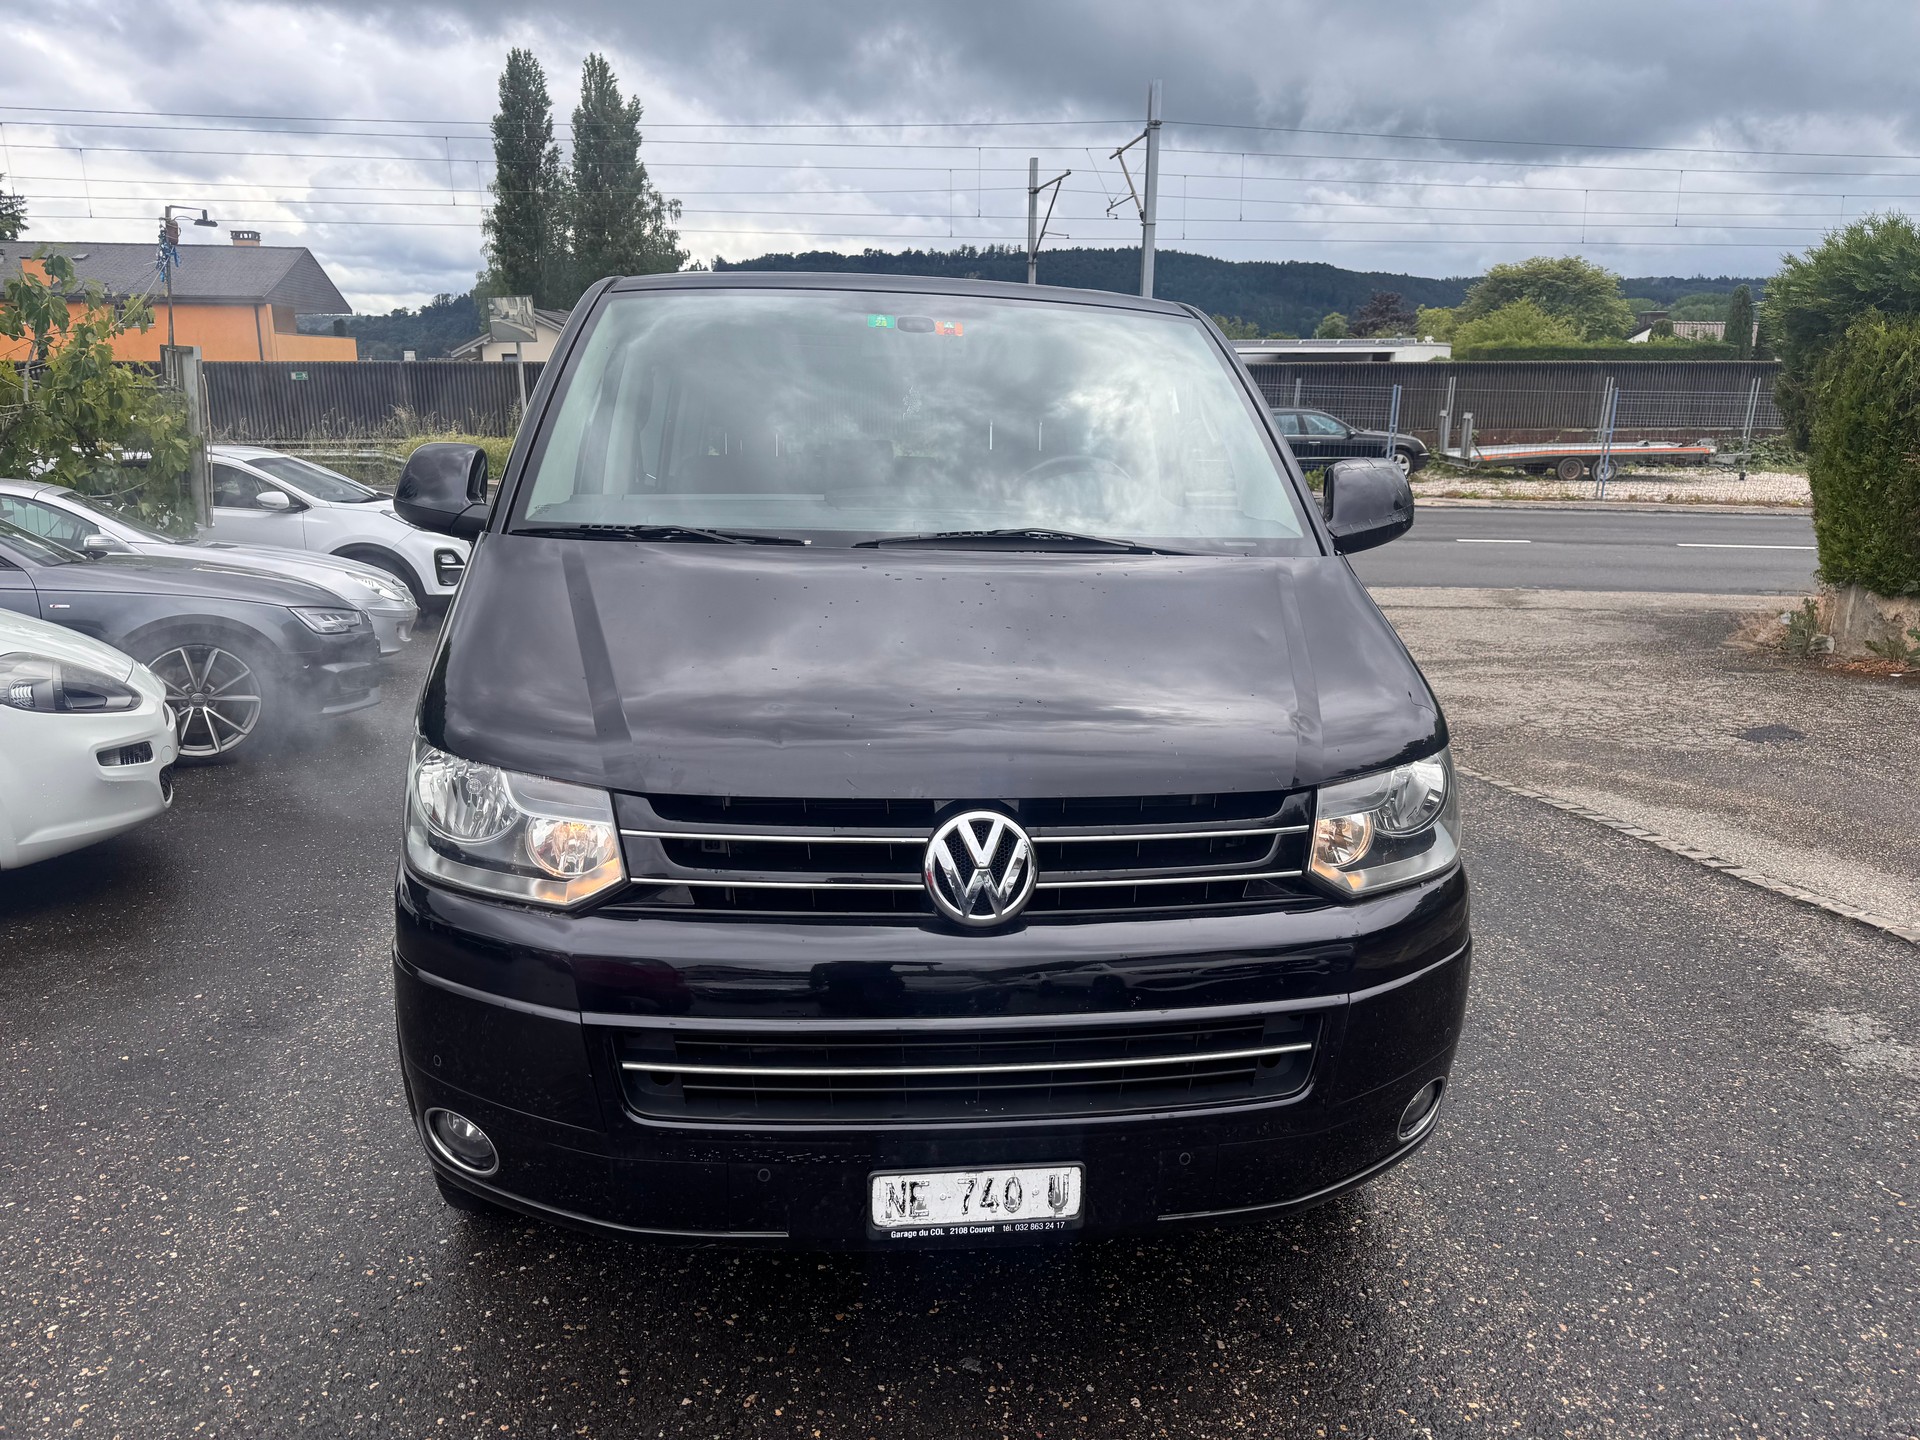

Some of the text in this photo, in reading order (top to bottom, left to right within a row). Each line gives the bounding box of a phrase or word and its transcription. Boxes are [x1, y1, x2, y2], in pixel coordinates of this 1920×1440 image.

[885, 1173, 1070, 1218] NE 740 U
[890, 1230, 918, 1239] Garage
[930, 1228, 946, 1236] COL
[949, 1227, 968, 1235] 2108
[969, 1225, 995, 1234] Couvet
[1014, 1223, 1029, 1231] 032
[1030, 1222, 1044, 1230] 863
[1045, 1221, 1054, 1230] 24
[1056, 1221, 1065, 1229] 17
